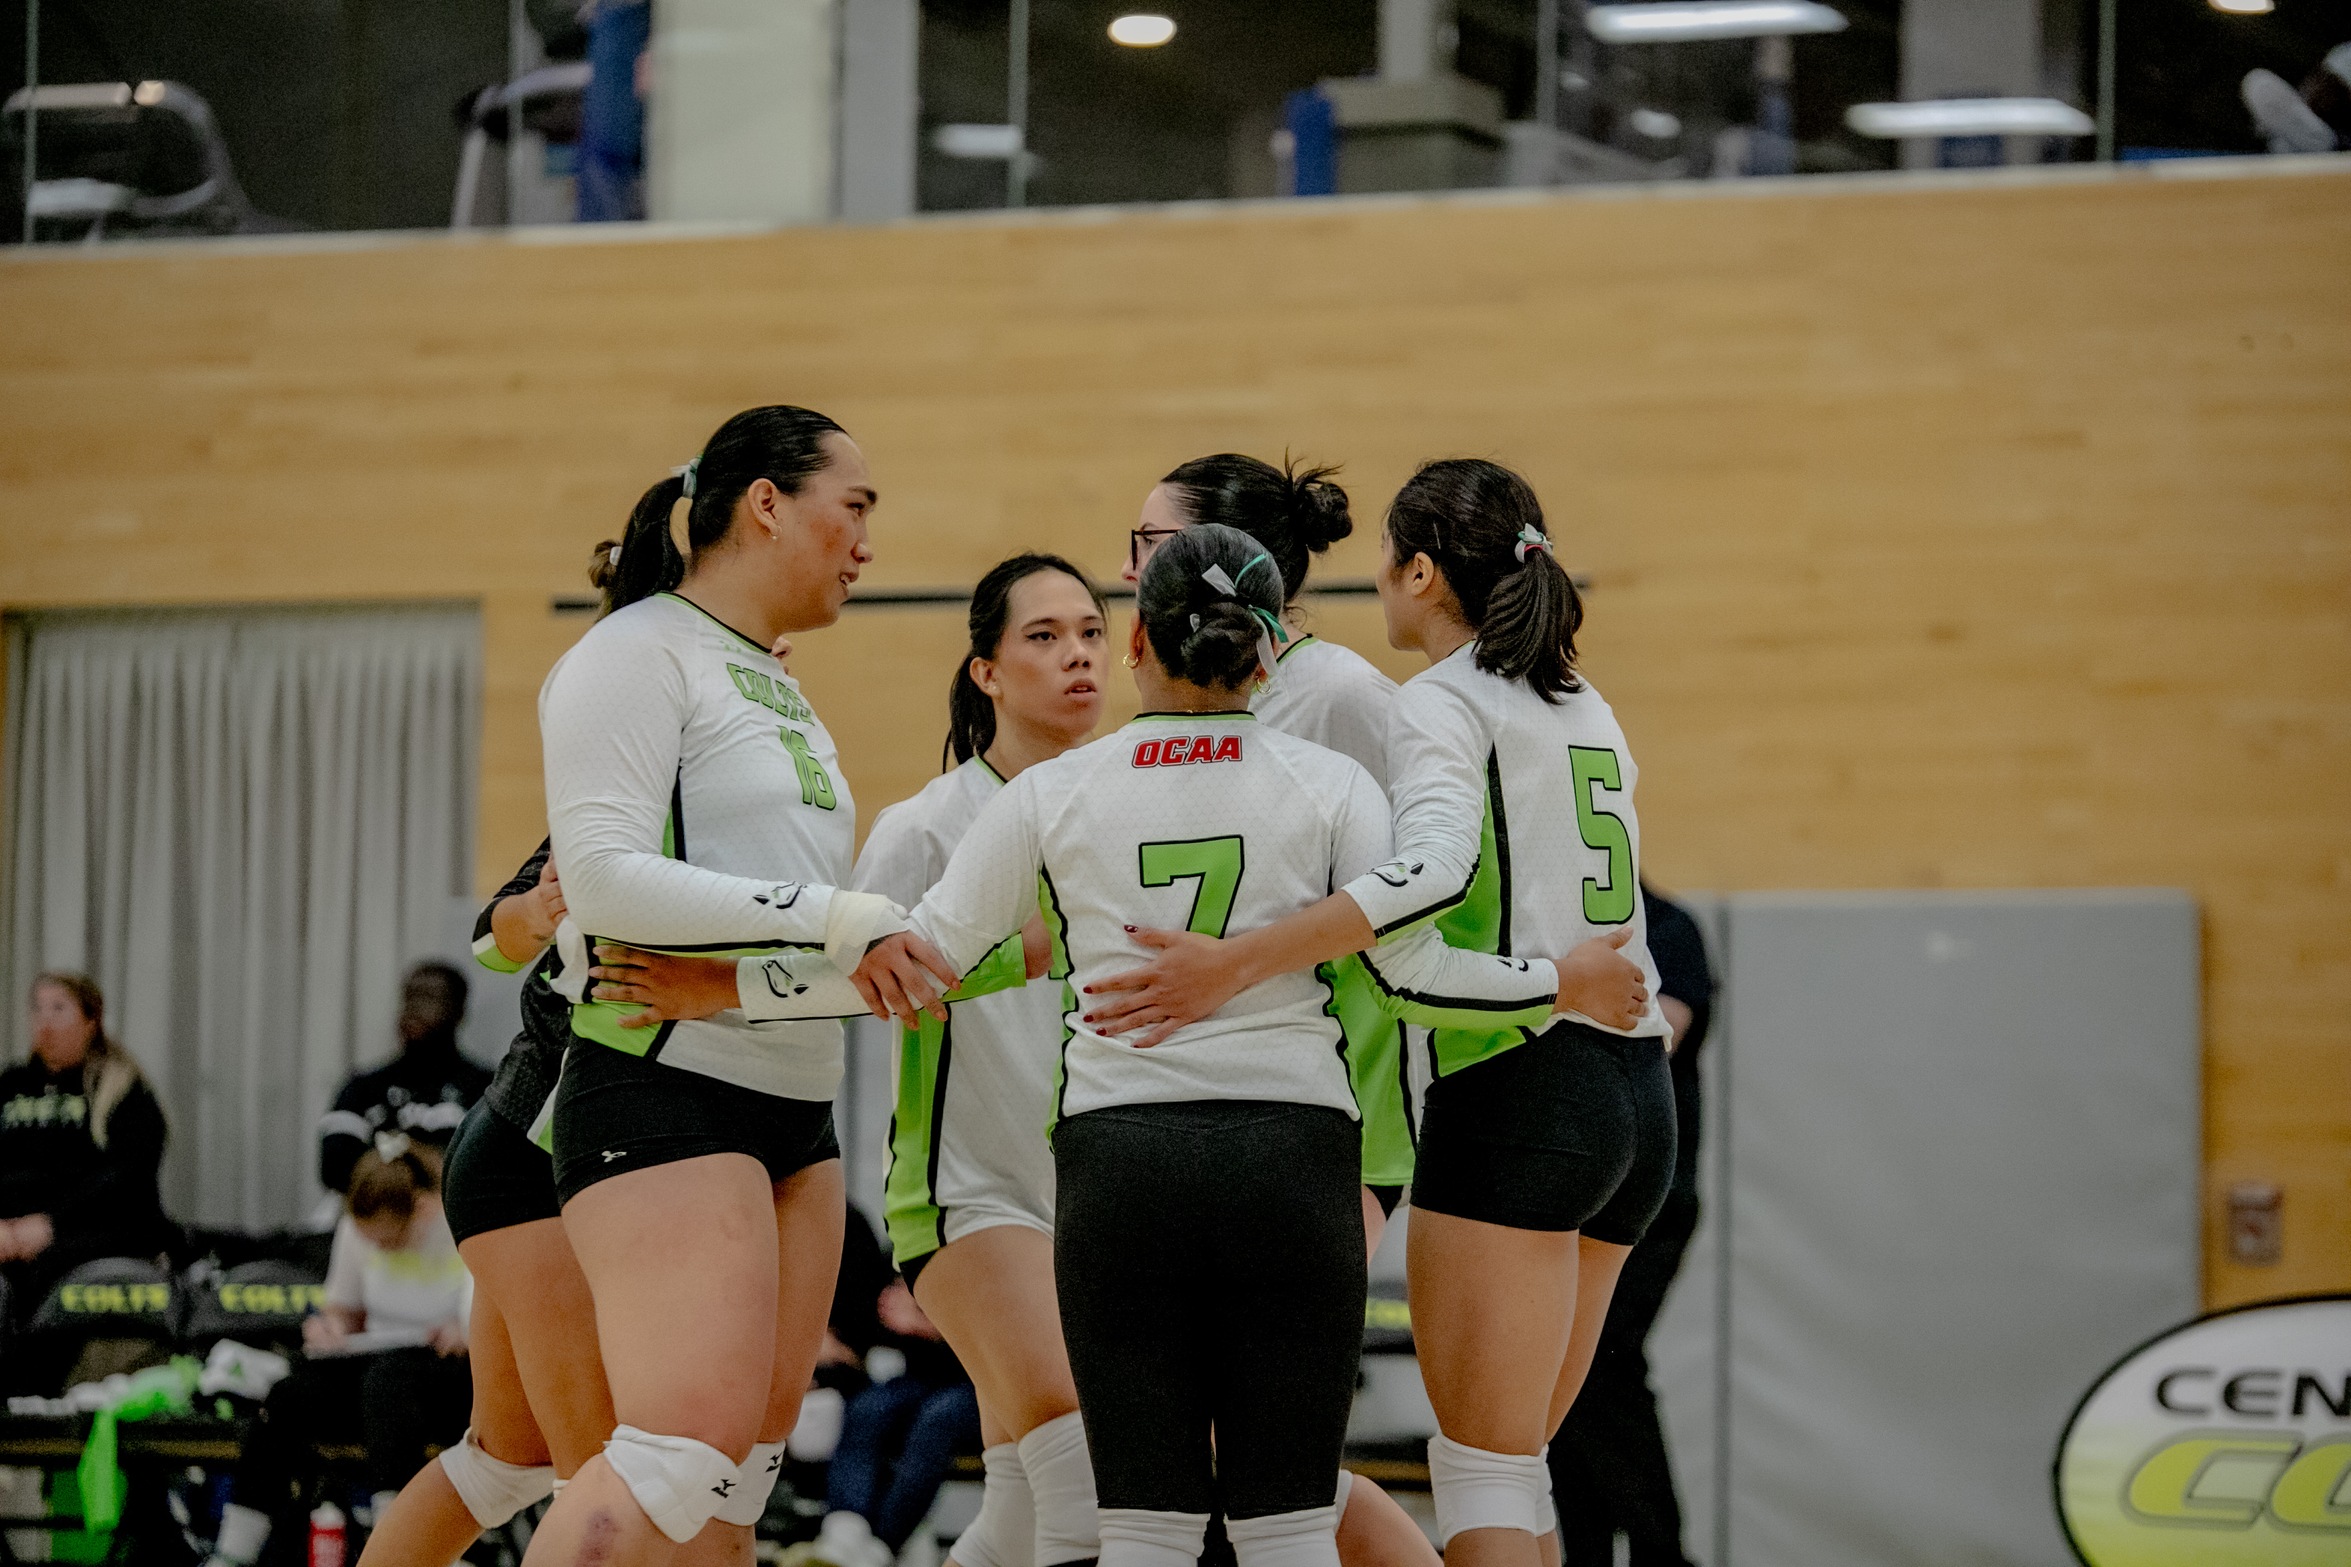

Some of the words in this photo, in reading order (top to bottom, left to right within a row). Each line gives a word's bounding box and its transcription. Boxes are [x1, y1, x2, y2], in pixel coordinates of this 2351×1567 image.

[776, 724, 837, 811] 16
[1132, 735, 1242, 768] OCAA
[1568, 744, 1635, 925] 5
[1138, 834, 1245, 939] 7
[60, 1283, 170, 1313] COLTS
[2156, 1367, 2351, 1417] CEN
